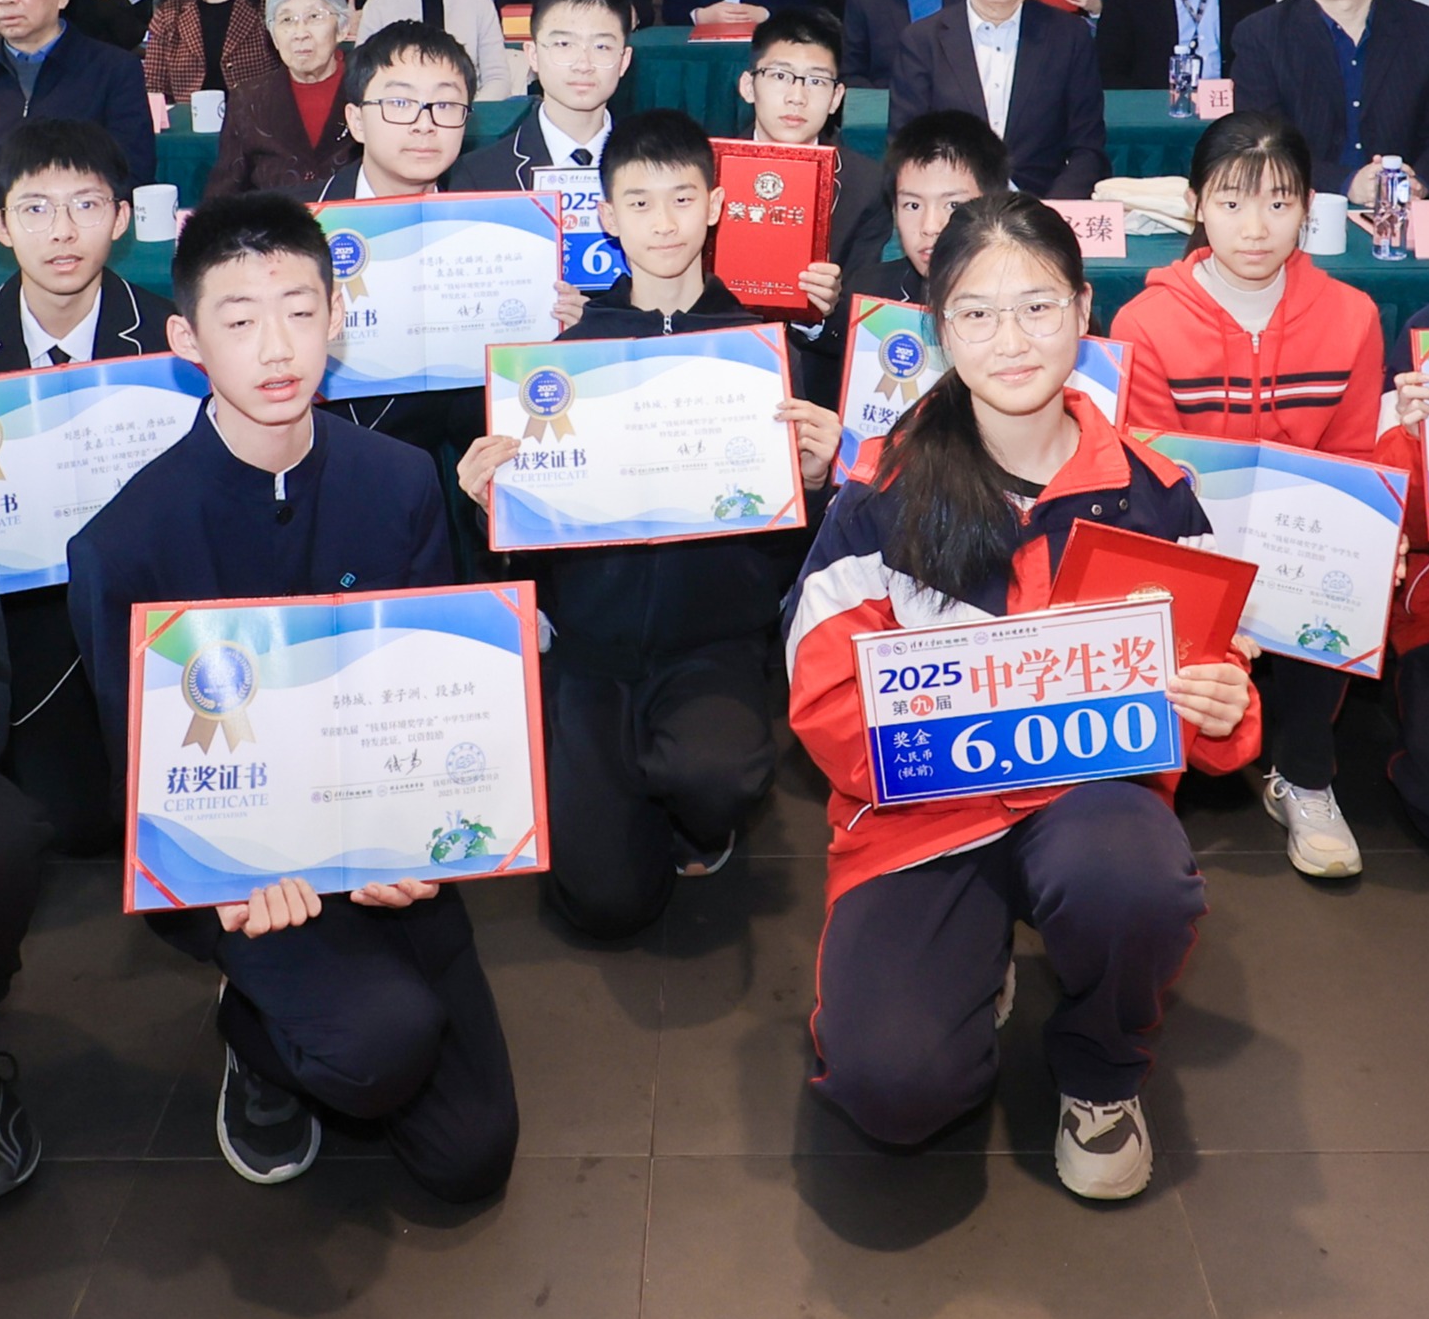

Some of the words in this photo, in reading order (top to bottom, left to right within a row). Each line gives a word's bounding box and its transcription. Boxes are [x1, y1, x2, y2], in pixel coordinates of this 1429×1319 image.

[561, 192, 600, 211] 025
[345, 309, 378, 328] 证书
[513, 447, 588, 471] 获奖证书
[511, 469, 589, 484] CERTIFICATE
[879, 661, 963, 694] 2025
[970, 636, 1159, 709] 中学生奖
[892, 694, 952, 716] 第九届
[893, 728, 932, 749] 奖金
[951, 701, 1158, 776] 6,000
[893, 748, 933, 764] 人民币
[166, 761, 268, 795] 获奖证书
[163, 792, 270, 813] CERTIFICATE
